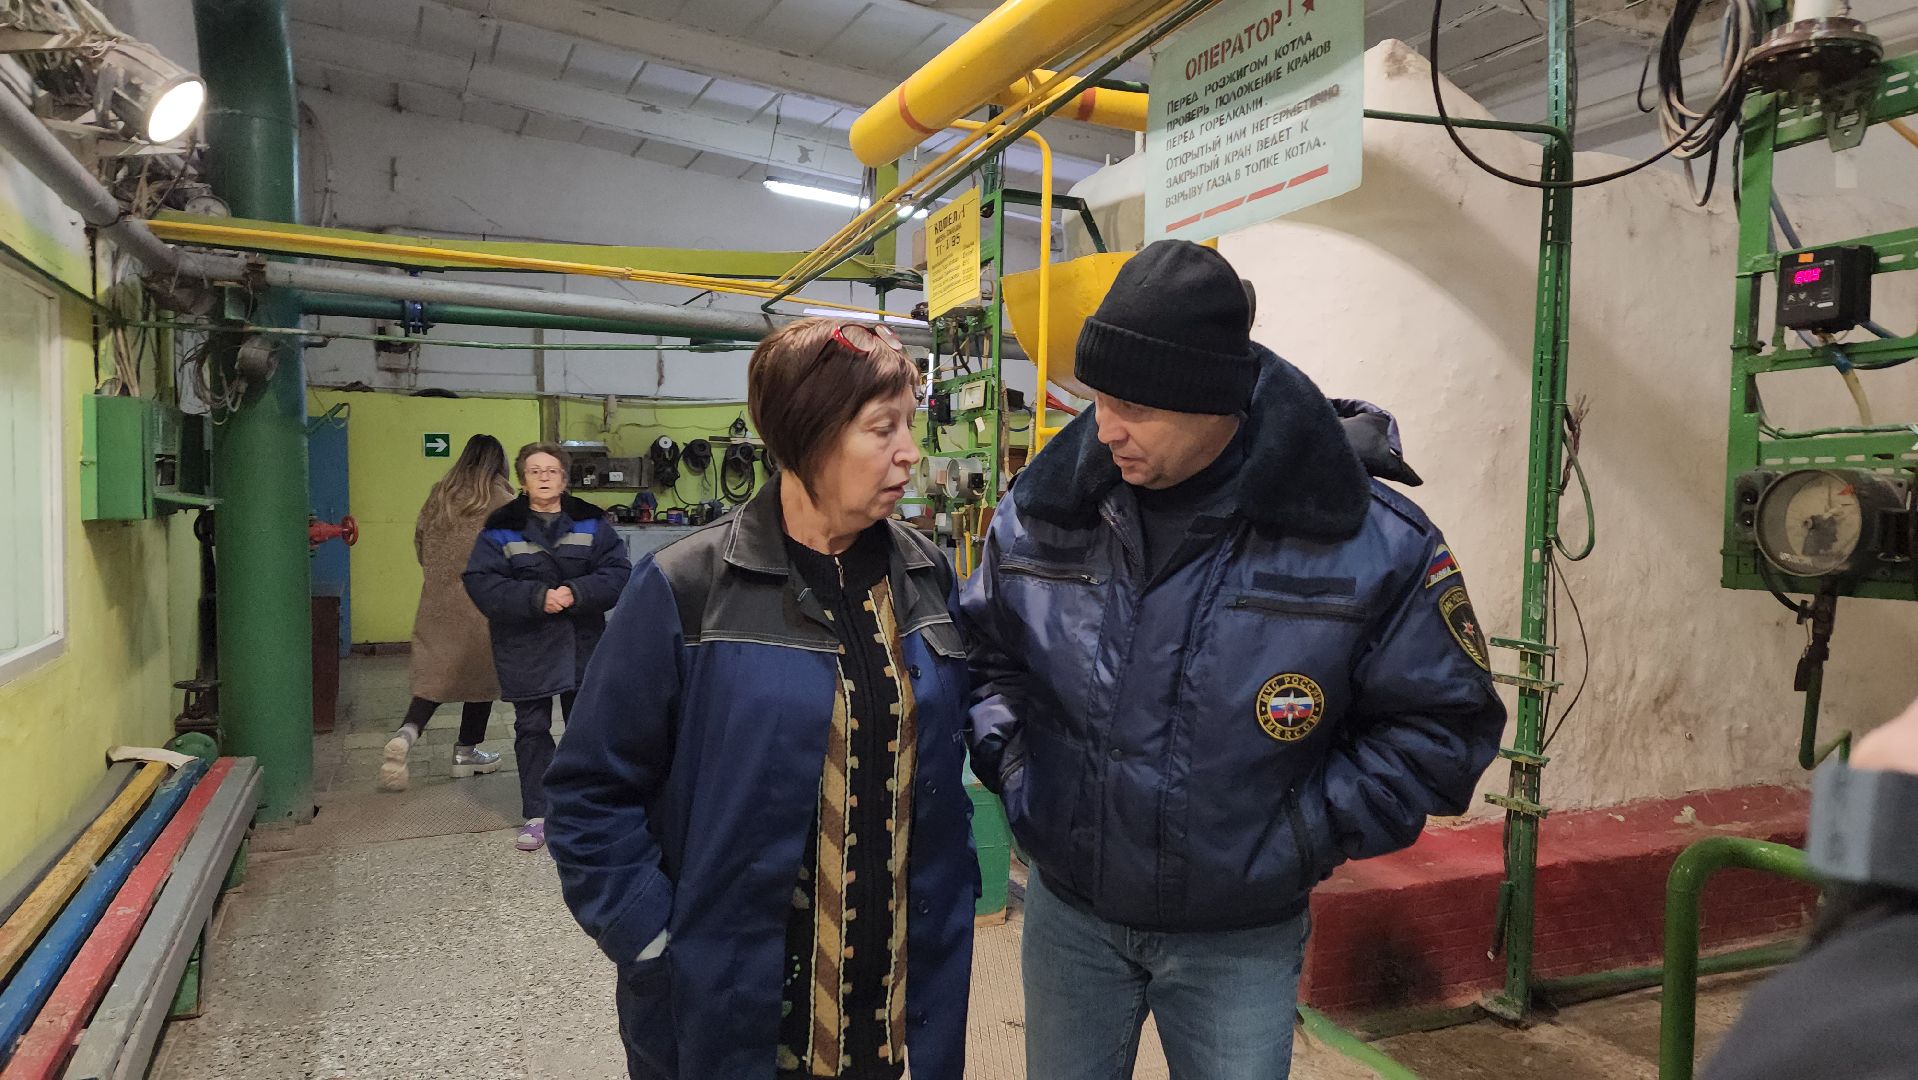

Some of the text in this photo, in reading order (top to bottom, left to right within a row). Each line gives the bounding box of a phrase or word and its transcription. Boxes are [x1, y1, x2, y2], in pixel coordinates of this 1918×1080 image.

[1166, 40, 1332, 133] ПРОВЕРЬ ПОЛОЖЕНИЕ КРАНОВ
[1167, 31, 1312, 115] ПЕРЕД РОЗЖИГОМ КОТЛА
[1166, 96, 1268, 151] ПЕРЕД ГОРЕЛКАМИ.
[1166, 135, 1221, 171] ОТКРЫТЫЙ
[1226, 126, 1247, 145] ИЛИ
[1166, 118, 1309, 189] ЗАКРЫТЫЙ КРАН ВЕДЕТ К
[1165, 136, 1327, 208] ВЗРЫВУ ГАЗА В ТОПКЕ КОТЛА.
[1260, 676, 1322, 704] МЧС РОССИИ
[1260, 714, 1319, 740] EMERCOM
